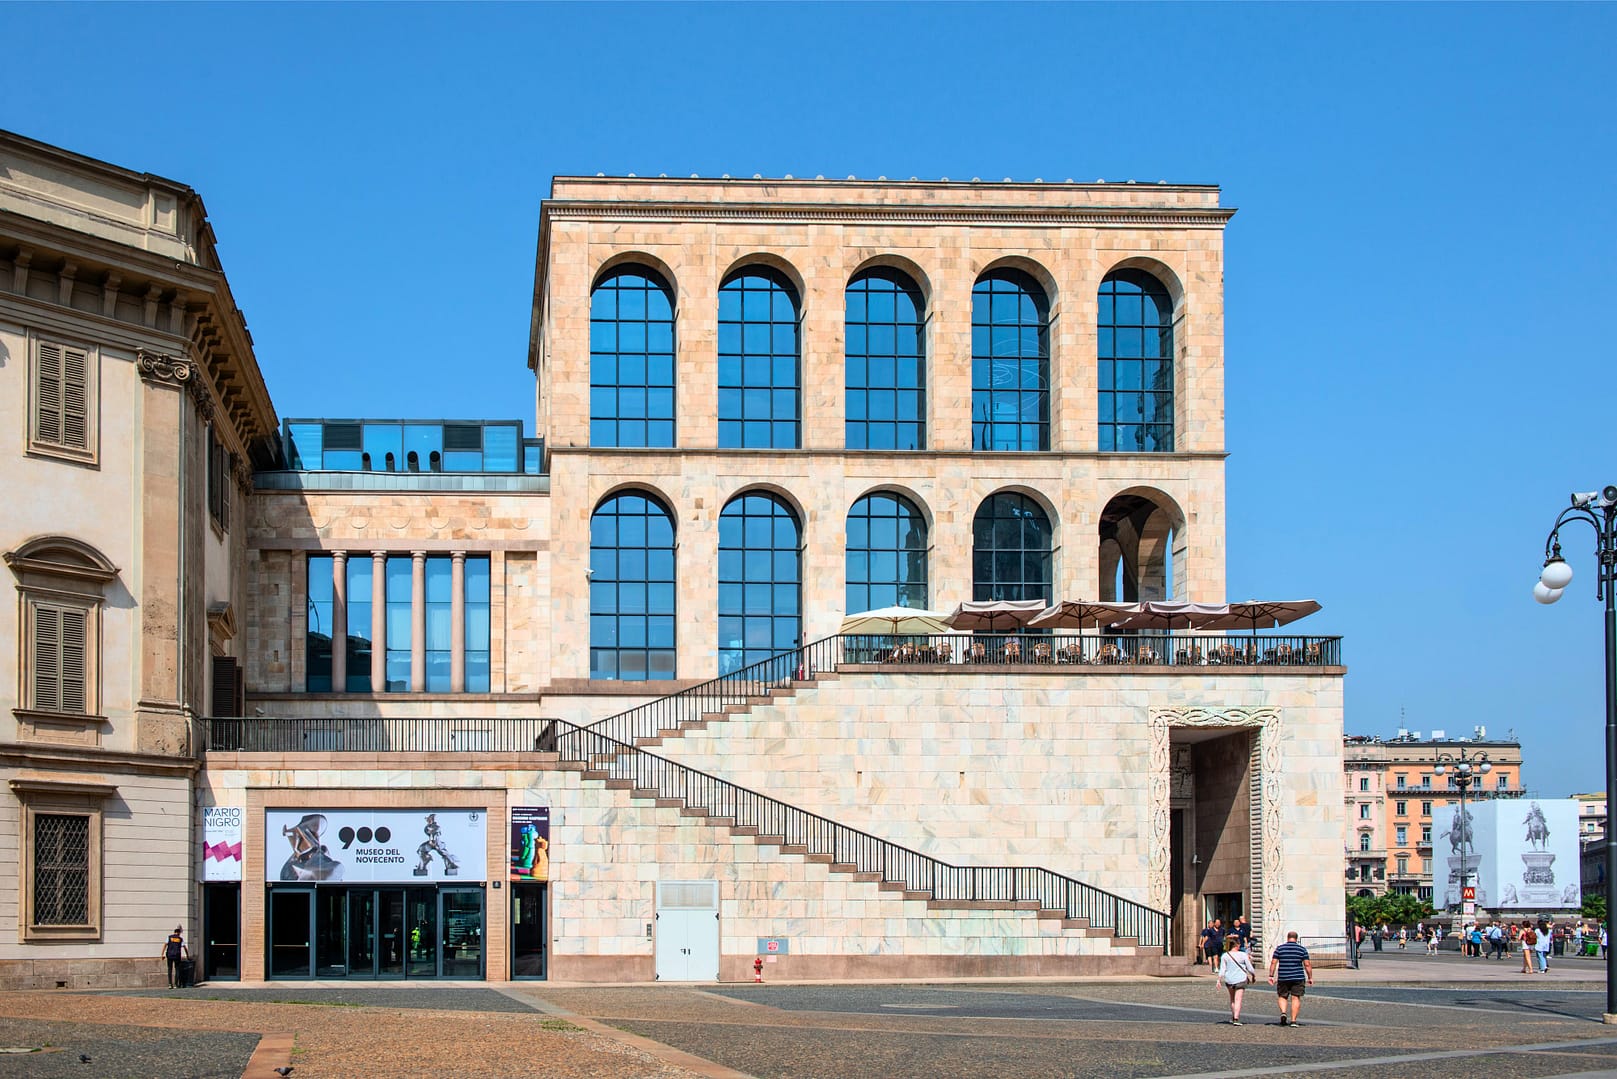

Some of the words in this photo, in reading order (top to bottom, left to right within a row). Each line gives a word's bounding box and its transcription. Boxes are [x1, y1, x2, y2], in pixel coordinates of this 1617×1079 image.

[204, 808, 240, 817] MARIO
[204, 818, 240, 827] NIGRO
[338, 826, 391, 850] 900
[355, 848, 384, 856] MUSEO
[386, 848, 400, 856] DEL
[355, 856, 405, 864] NOVECENTO
[1464, 888, 1474, 897] M
